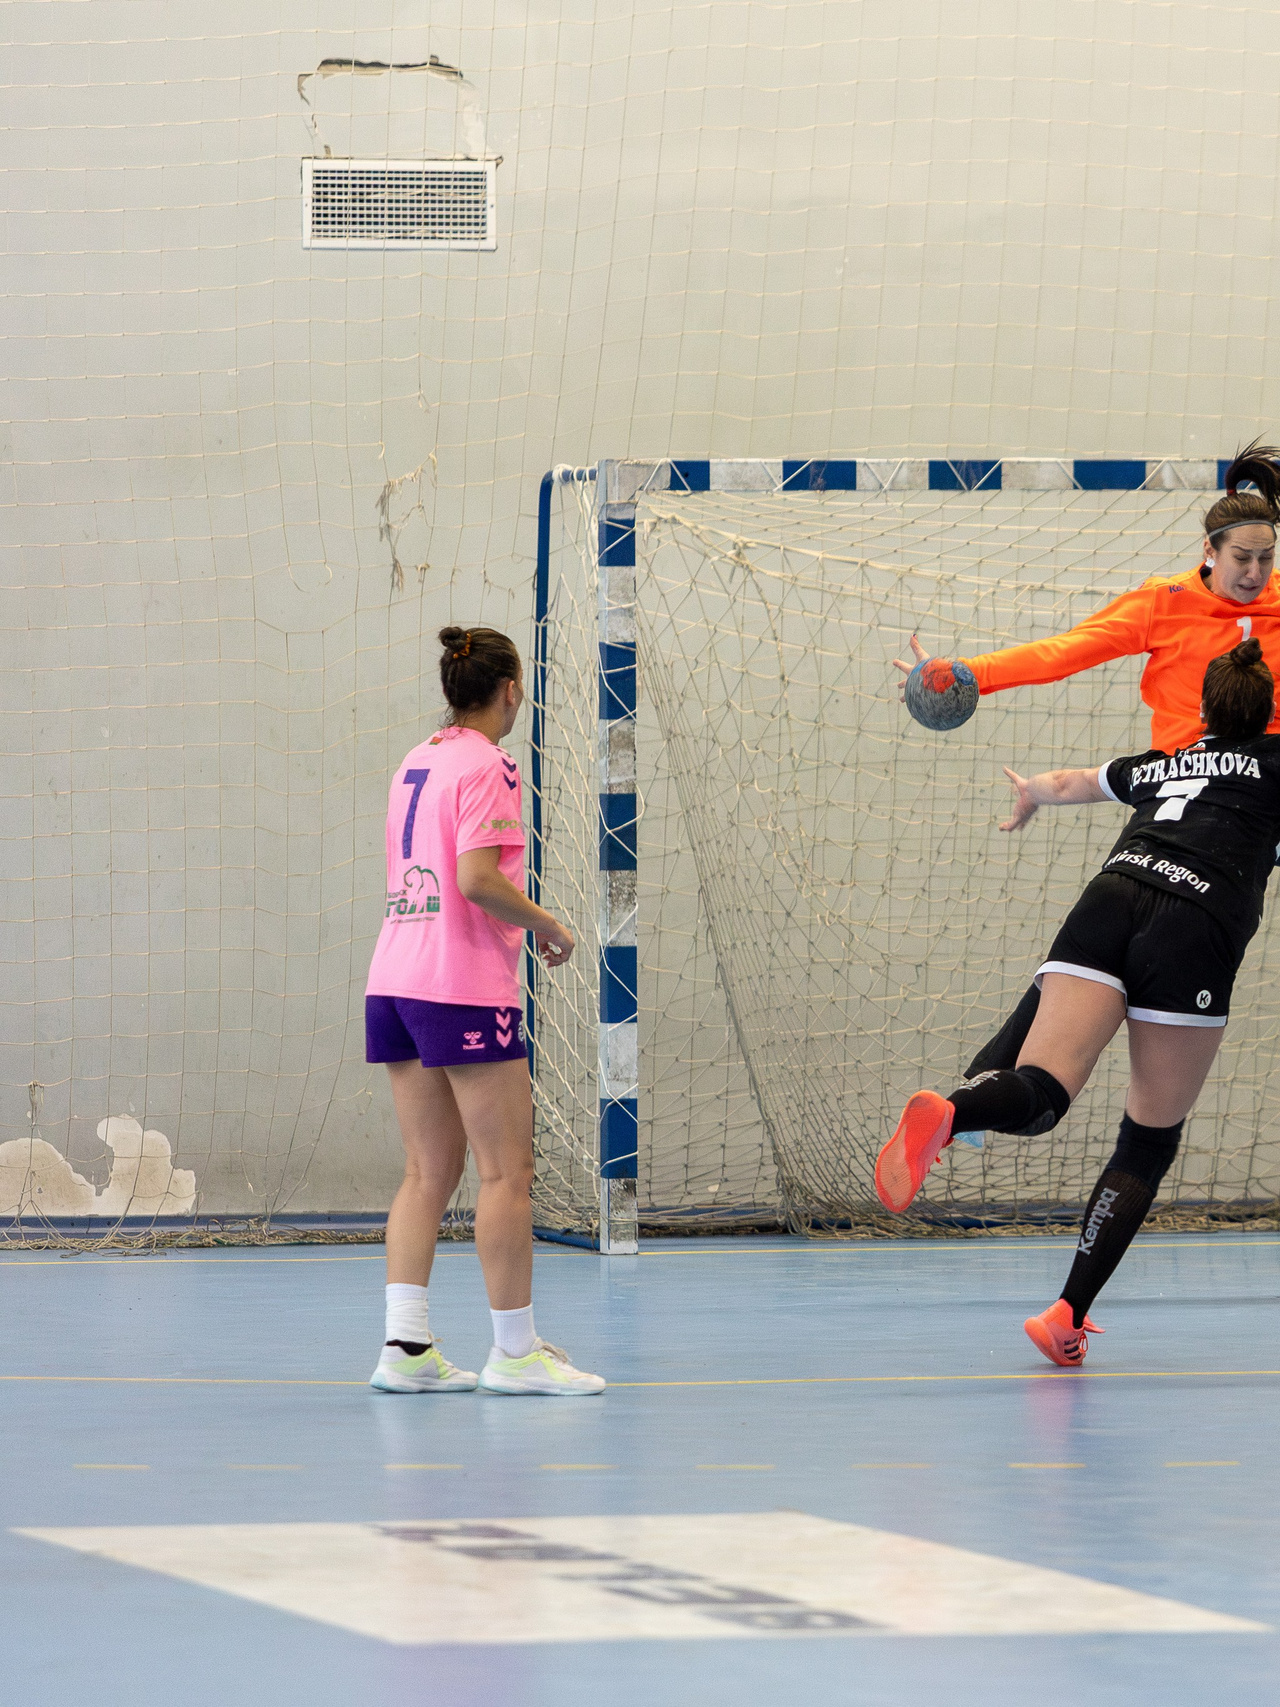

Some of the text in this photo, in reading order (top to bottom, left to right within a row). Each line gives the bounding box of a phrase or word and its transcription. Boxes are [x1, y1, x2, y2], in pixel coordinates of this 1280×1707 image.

[1236, 615, 1252, 642] 1
[402, 769, 431, 859] 7
[1153, 777, 1210, 821] 7
[1152, 860, 1210, 893] Region
[1078, 1187, 1120, 1255] Kempa
